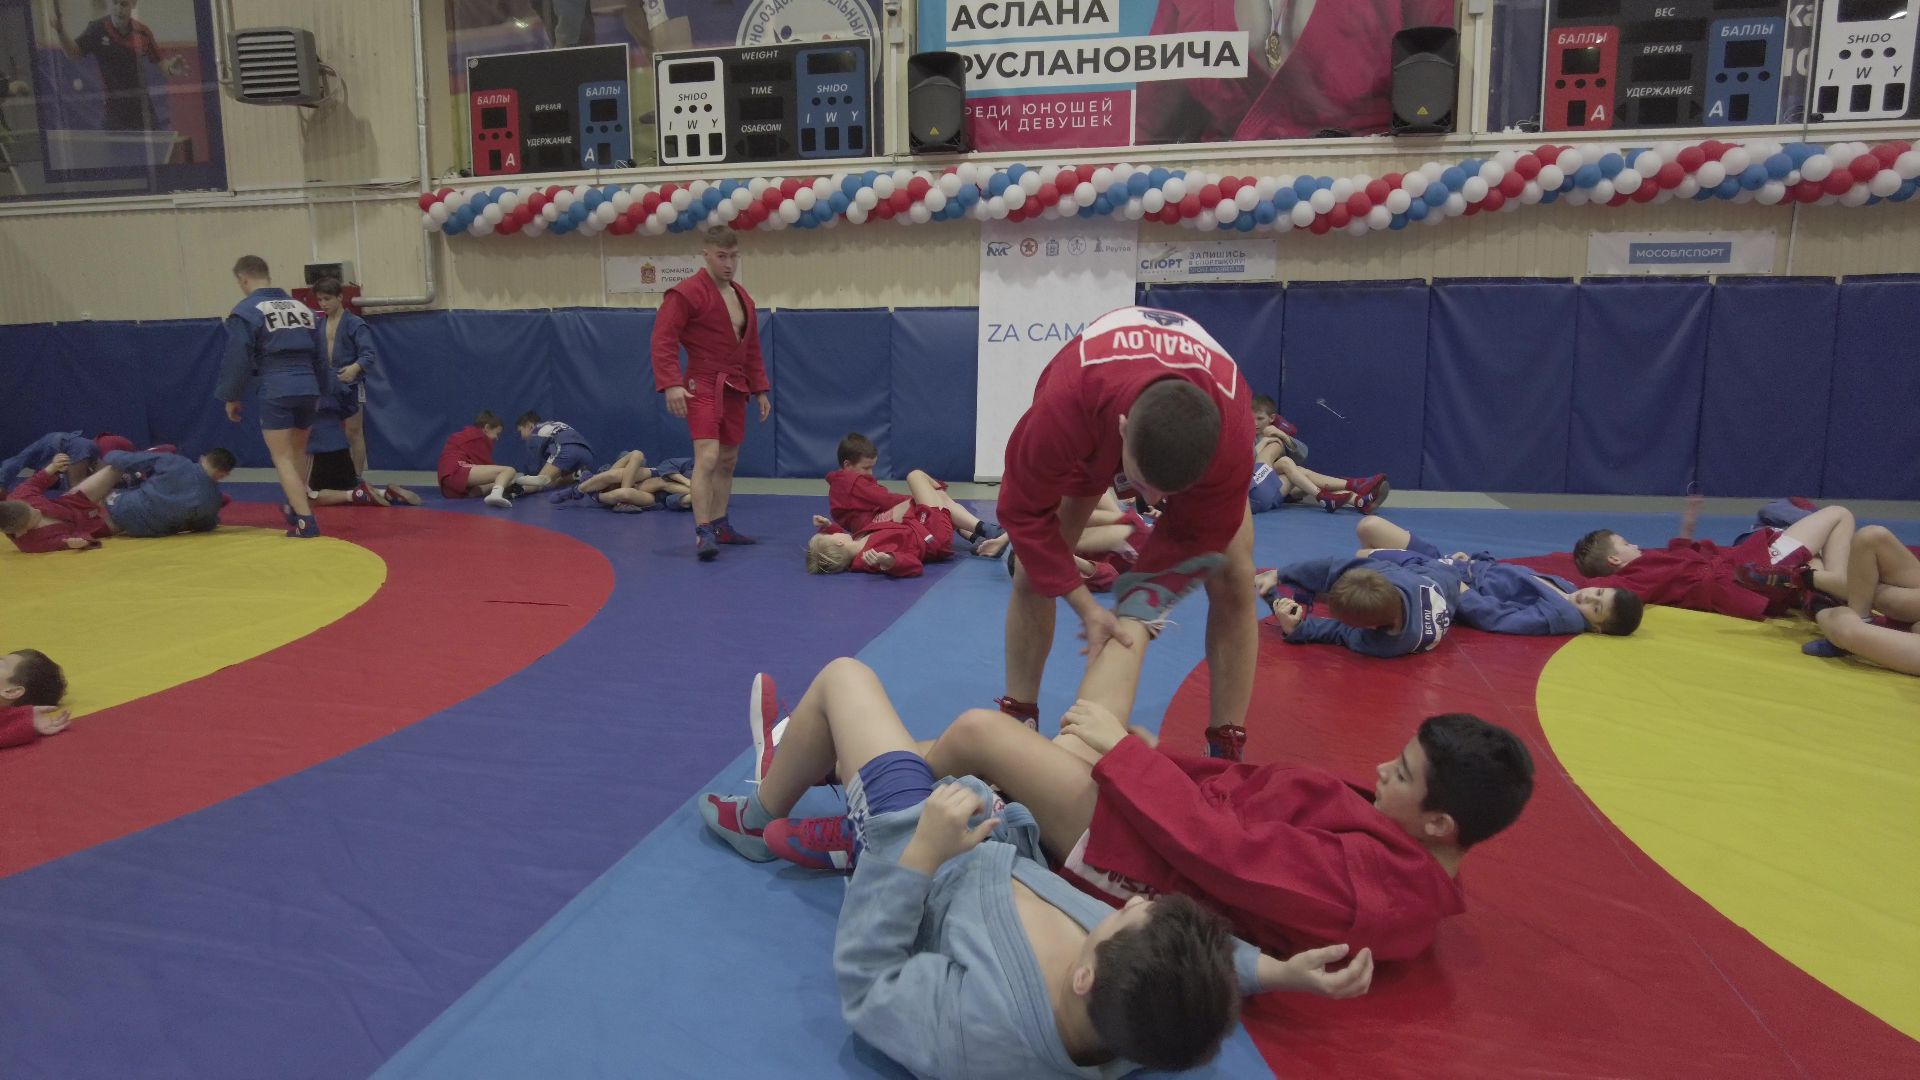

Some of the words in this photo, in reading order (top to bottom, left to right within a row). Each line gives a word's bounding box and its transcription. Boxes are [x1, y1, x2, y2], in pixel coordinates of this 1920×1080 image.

[951, 0, 1110, 32] АСЛАНА
[1654, 7, 1676, 18] ВЕС
[1721, 24, 1774, 37] БАЛЛЫ
[1558, 33, 1608, 45] БАЛЛЫ
[1848, 33, 1891, 44] SHIDO
[741, 50, 779, 61] WEIGHT
[1643, 45, 1682, 54] ВРЕМЯ
[1856, 66, 1872, 79] W
[1892, 65, 1902, 78] Y
[586, 86, 621, 97] БАЛЛЫ
[751, 86, 773, 95] TIME
[817, 84, 848, 93] SHIDO
[1626, 85, 1693, 98] УДЕРЖАНИЕ
[477, 94, 511, 105] БАЛЛЫ
[678, 92, 708, 101] SHIDO
[535, 103, 562, 112] ВРЕМЯ
[964, 104, 1011, 119] РЕДИ
[1022, 97, 1113, 116] ЮНОШЕЙ
[1590, 105, 1606, 121] А
[1708, 100, 1723, 118] А
[826, 112, 838, 123] W
[851, 110, 859, 121] Y
[687, 119, 698, 130] W
[711, 118, 719, 128] Y
[741, 123, 782, 133] OSAEKOMI
[998, 119, 1008, 131] И
[1018, 117, 1113, 133] ДЕВУШЕК
[526, 135, 572, 147] УДЕРЖАНИЕ
[505, 153, 515, 167] А
[585, 147, 595, 162] А
[1189, 250, 1246, 259] ЗАПИШИСЬ
[1636, 248, 1725, 258] МОСОБЛСПОРТ
[1141, 258, 1183, 270] СПОРТ
[265, 311, 311, 329] FIAS
[1028, 322, 1085, 342] САМ
